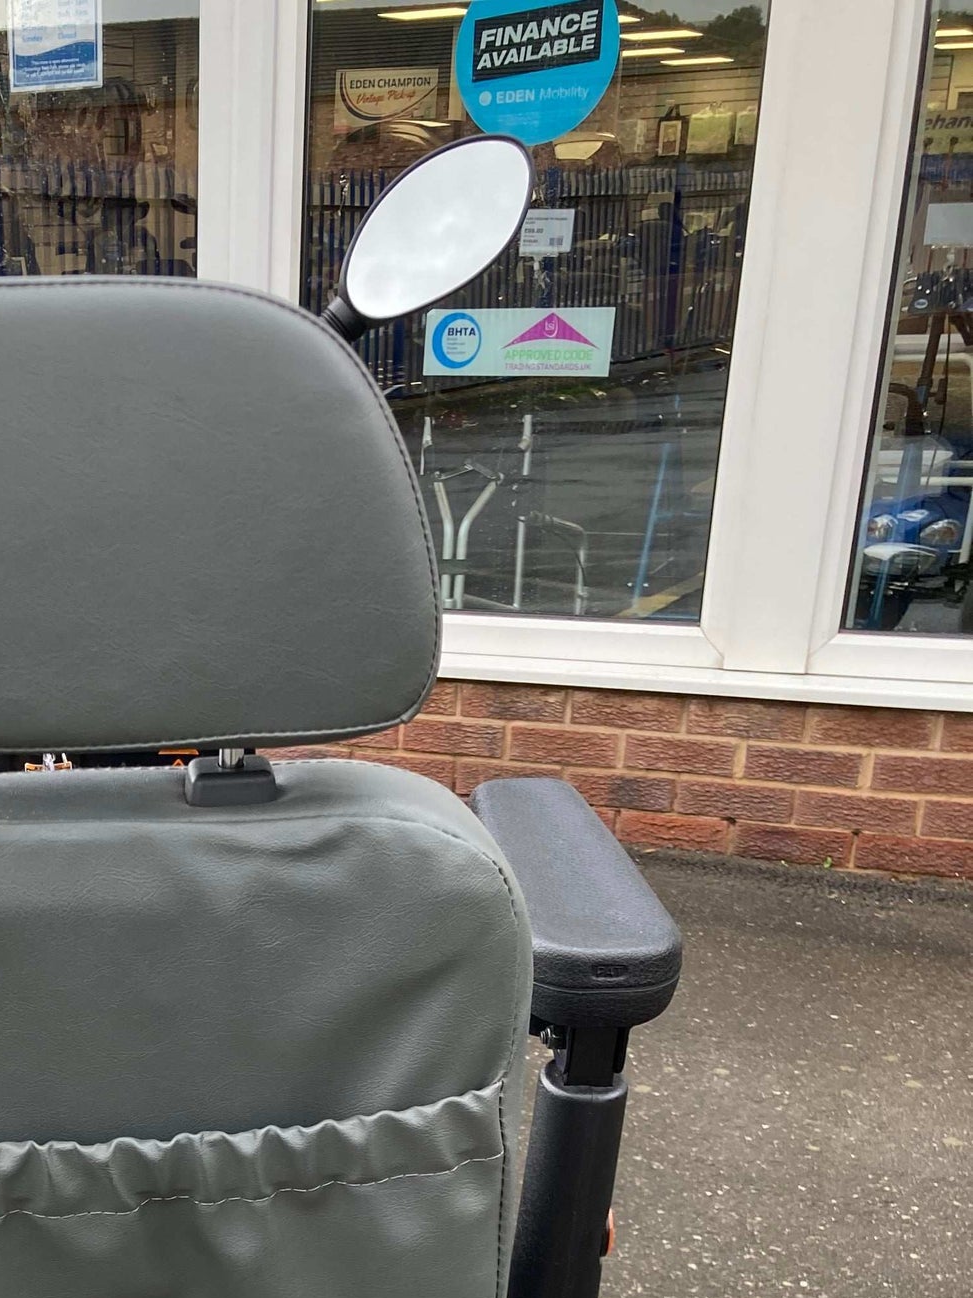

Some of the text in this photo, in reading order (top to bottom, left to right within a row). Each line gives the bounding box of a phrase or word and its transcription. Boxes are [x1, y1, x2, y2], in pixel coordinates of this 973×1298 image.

[479, 9, 599, 50] FINANCE
[476, 33, 597, 71] AVAILABLE
[349, 77, 431, 89] EDEN CHAMPION
[496, 86, 589, 104] EDEN Mobility
[447, 327, 476, 336] BHTA
[504, 349, 593, 361] APPROVED CODE
